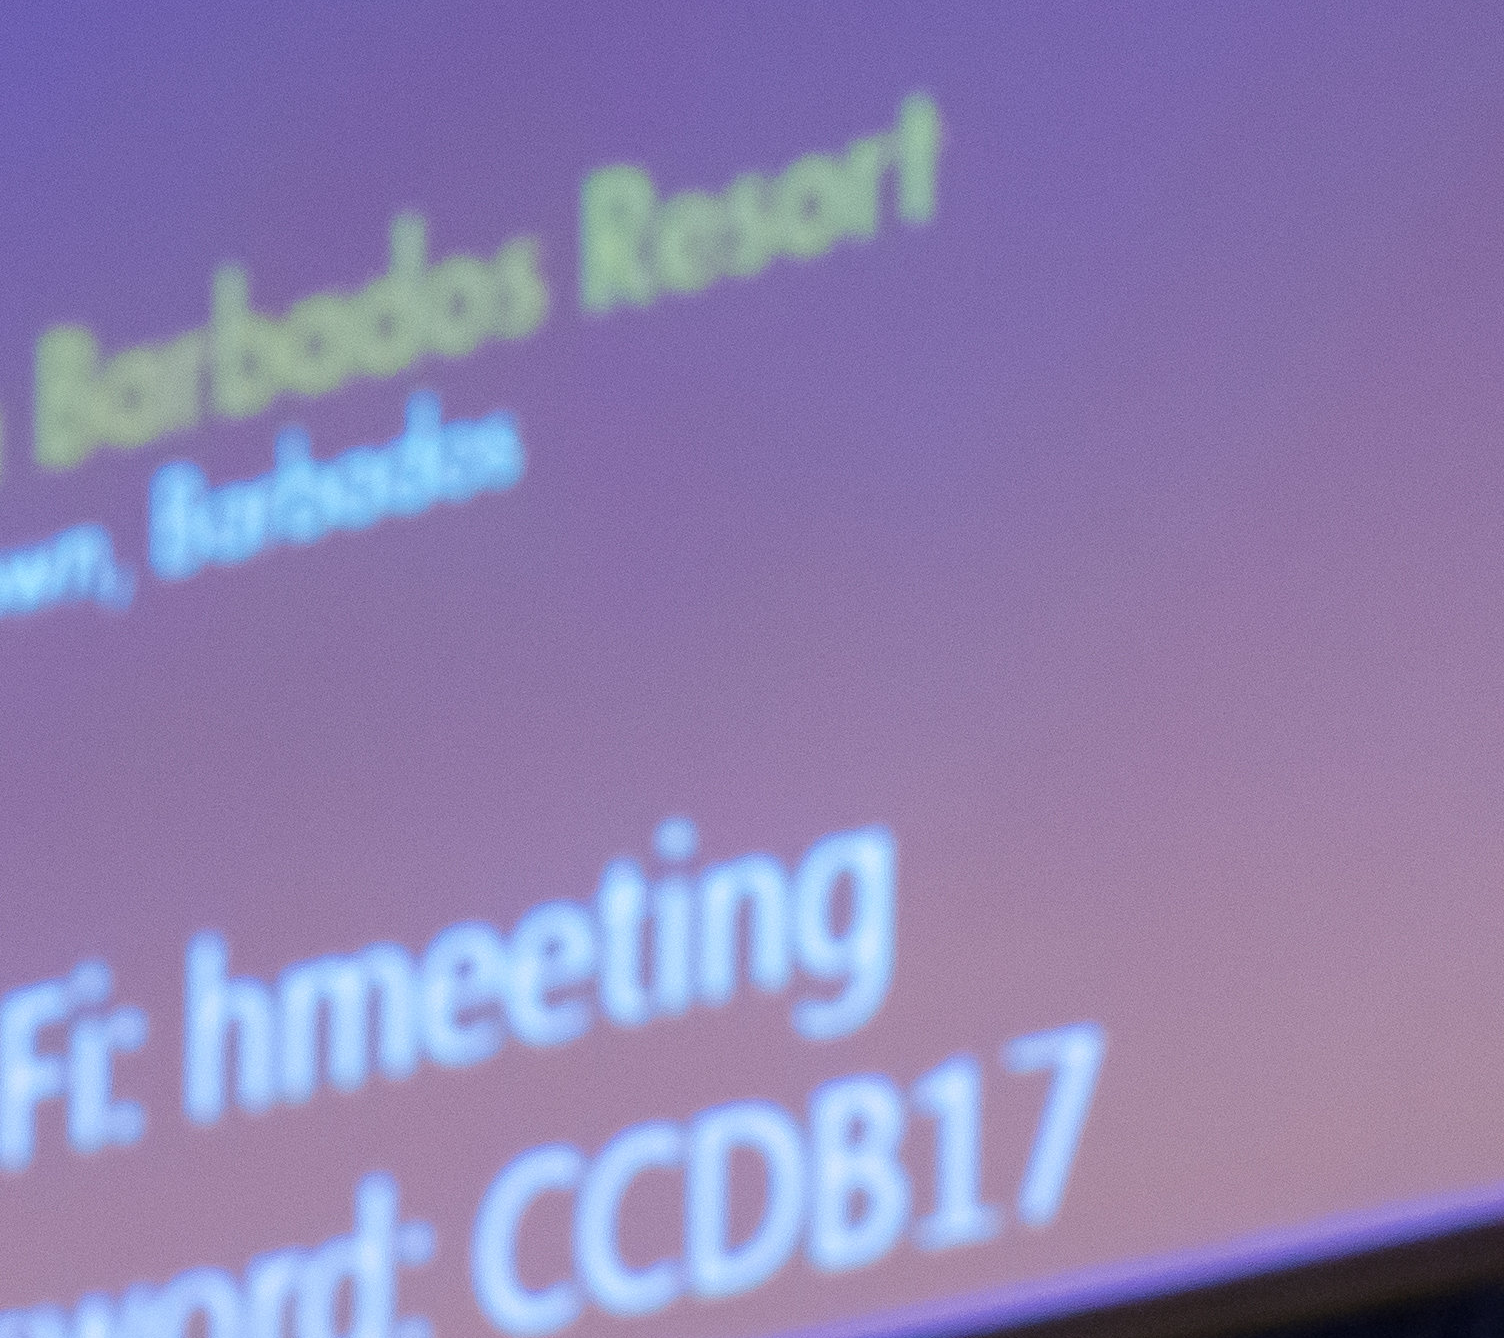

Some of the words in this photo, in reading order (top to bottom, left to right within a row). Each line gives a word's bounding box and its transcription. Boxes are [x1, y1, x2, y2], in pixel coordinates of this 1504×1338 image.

[32, 211, 550, 471] Barbados
[579, 92, 940, 311] Resort
[148, 390, 523, 577] Barbados
[184, 817, 897, 1123] hmeeting
[473, 1021, 1104, 1338] CCDB17
